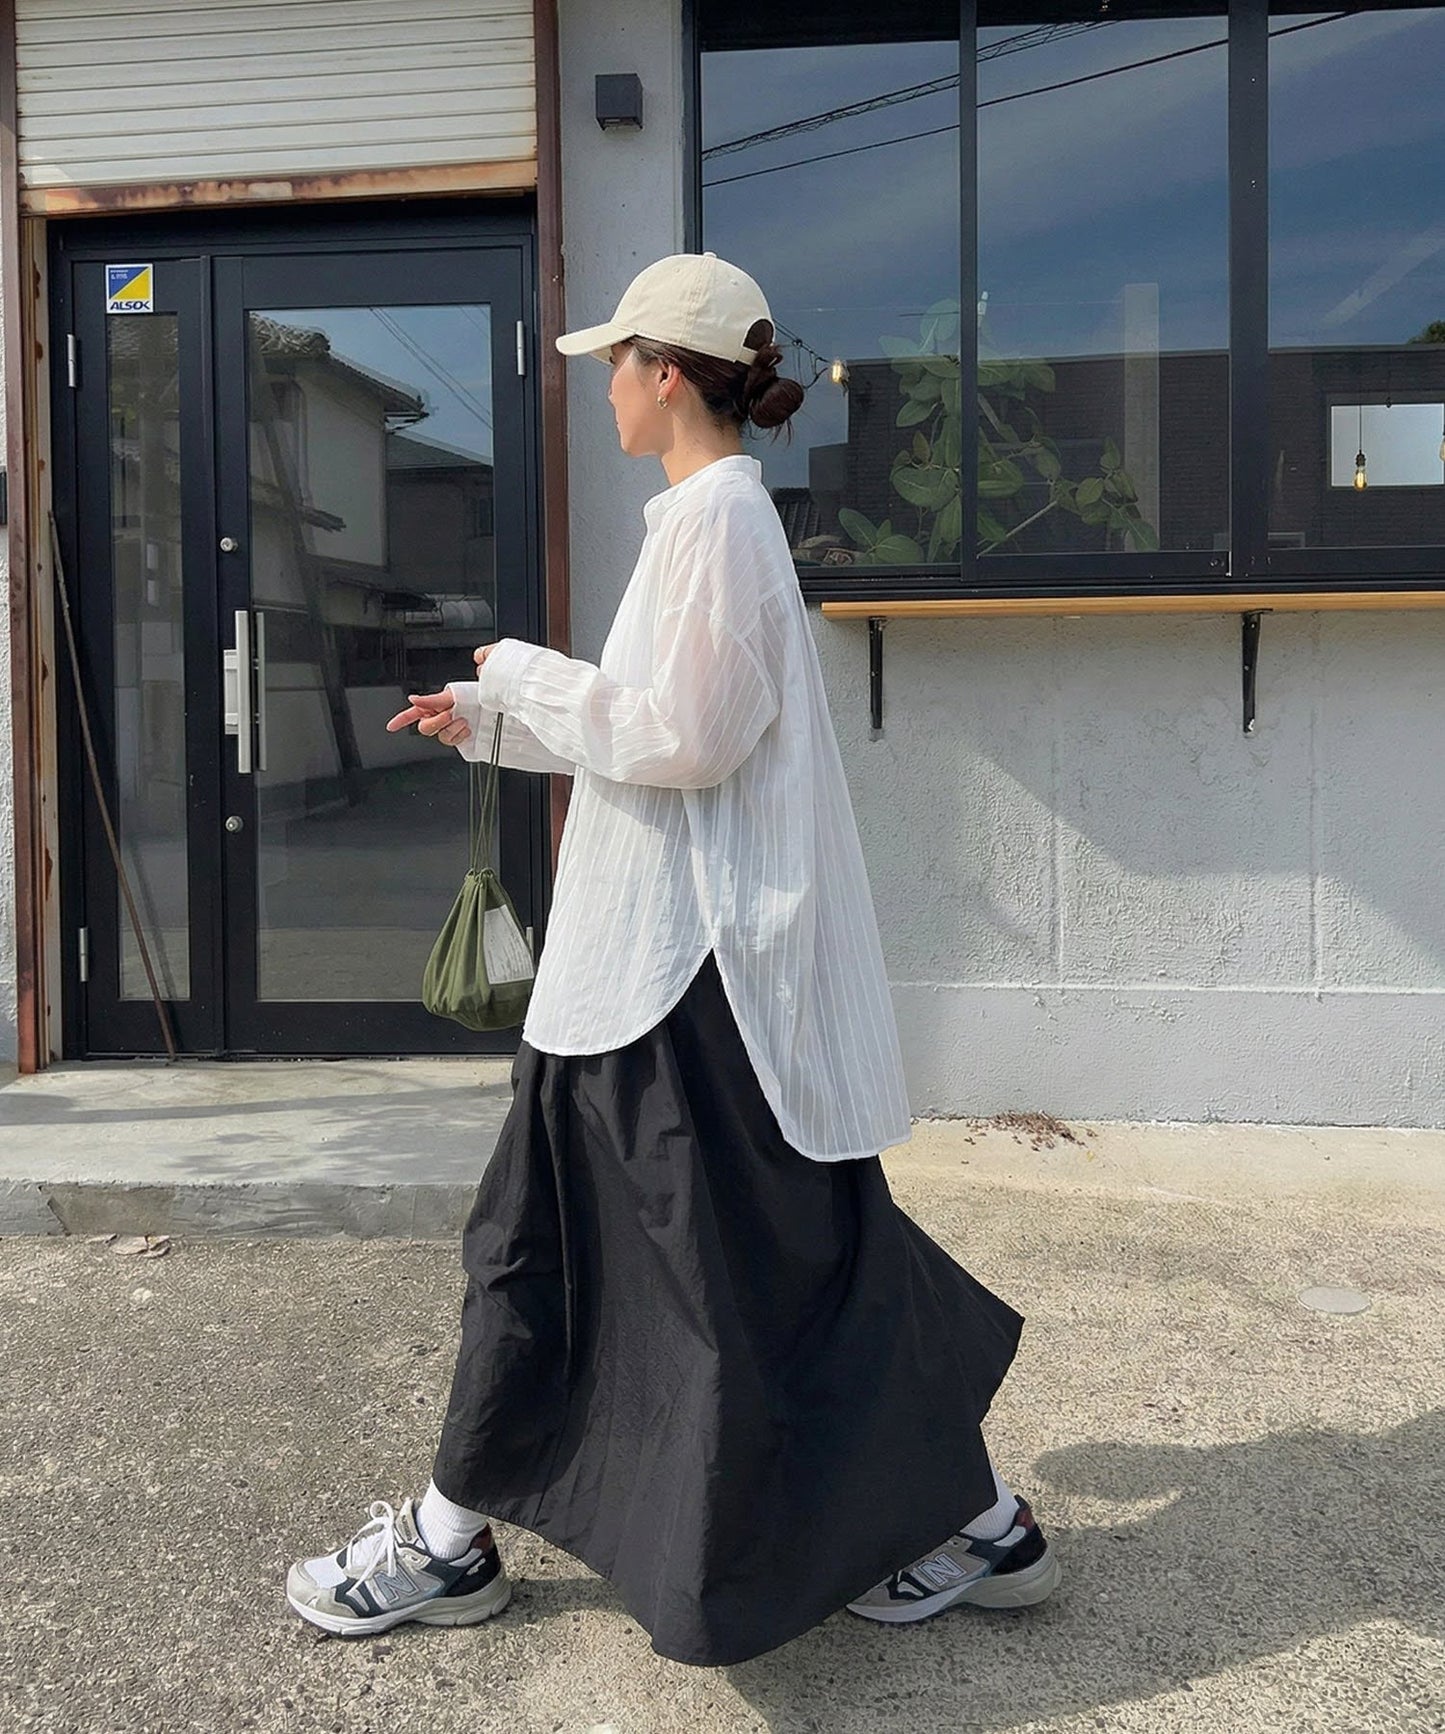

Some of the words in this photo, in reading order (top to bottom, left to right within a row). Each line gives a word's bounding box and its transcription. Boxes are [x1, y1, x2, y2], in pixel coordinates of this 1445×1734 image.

[110, 301, 150, 310] ALSOK
[373, 1567, 420, 1604] N
[918, 1553, 967, 1586] N
